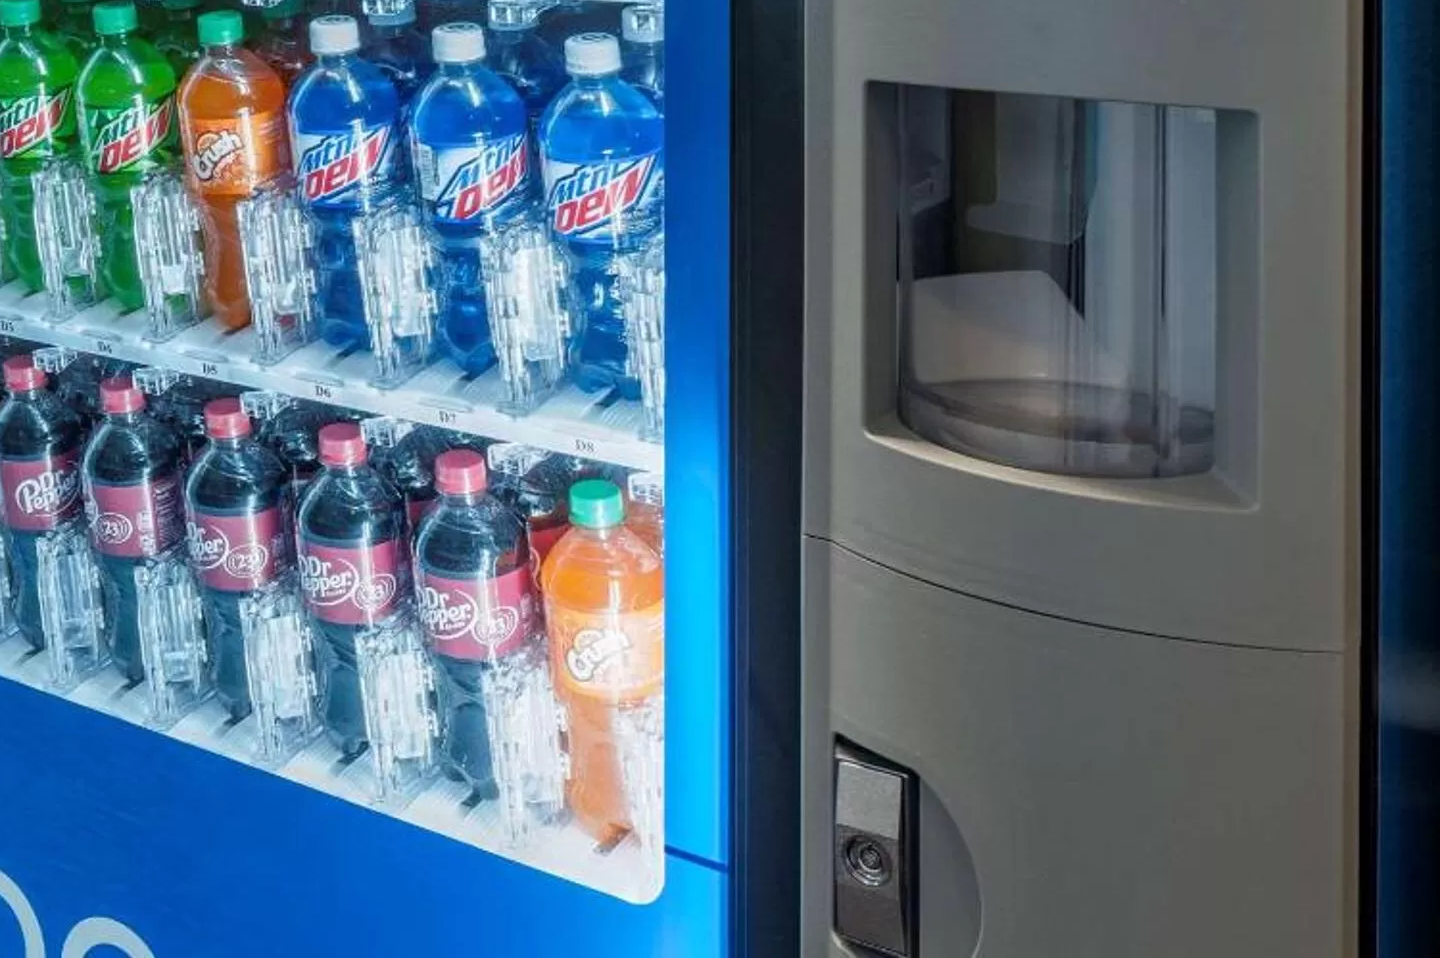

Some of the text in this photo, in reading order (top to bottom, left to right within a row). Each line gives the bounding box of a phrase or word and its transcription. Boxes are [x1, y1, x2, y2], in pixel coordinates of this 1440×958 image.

[203, 363, 217, 375] D5
[315, 386, 331, 398] D6
[576, 439, 596, 453] D8
[308, 556, 331, 576] Dr
[426, 587, 449, 609] Dr
